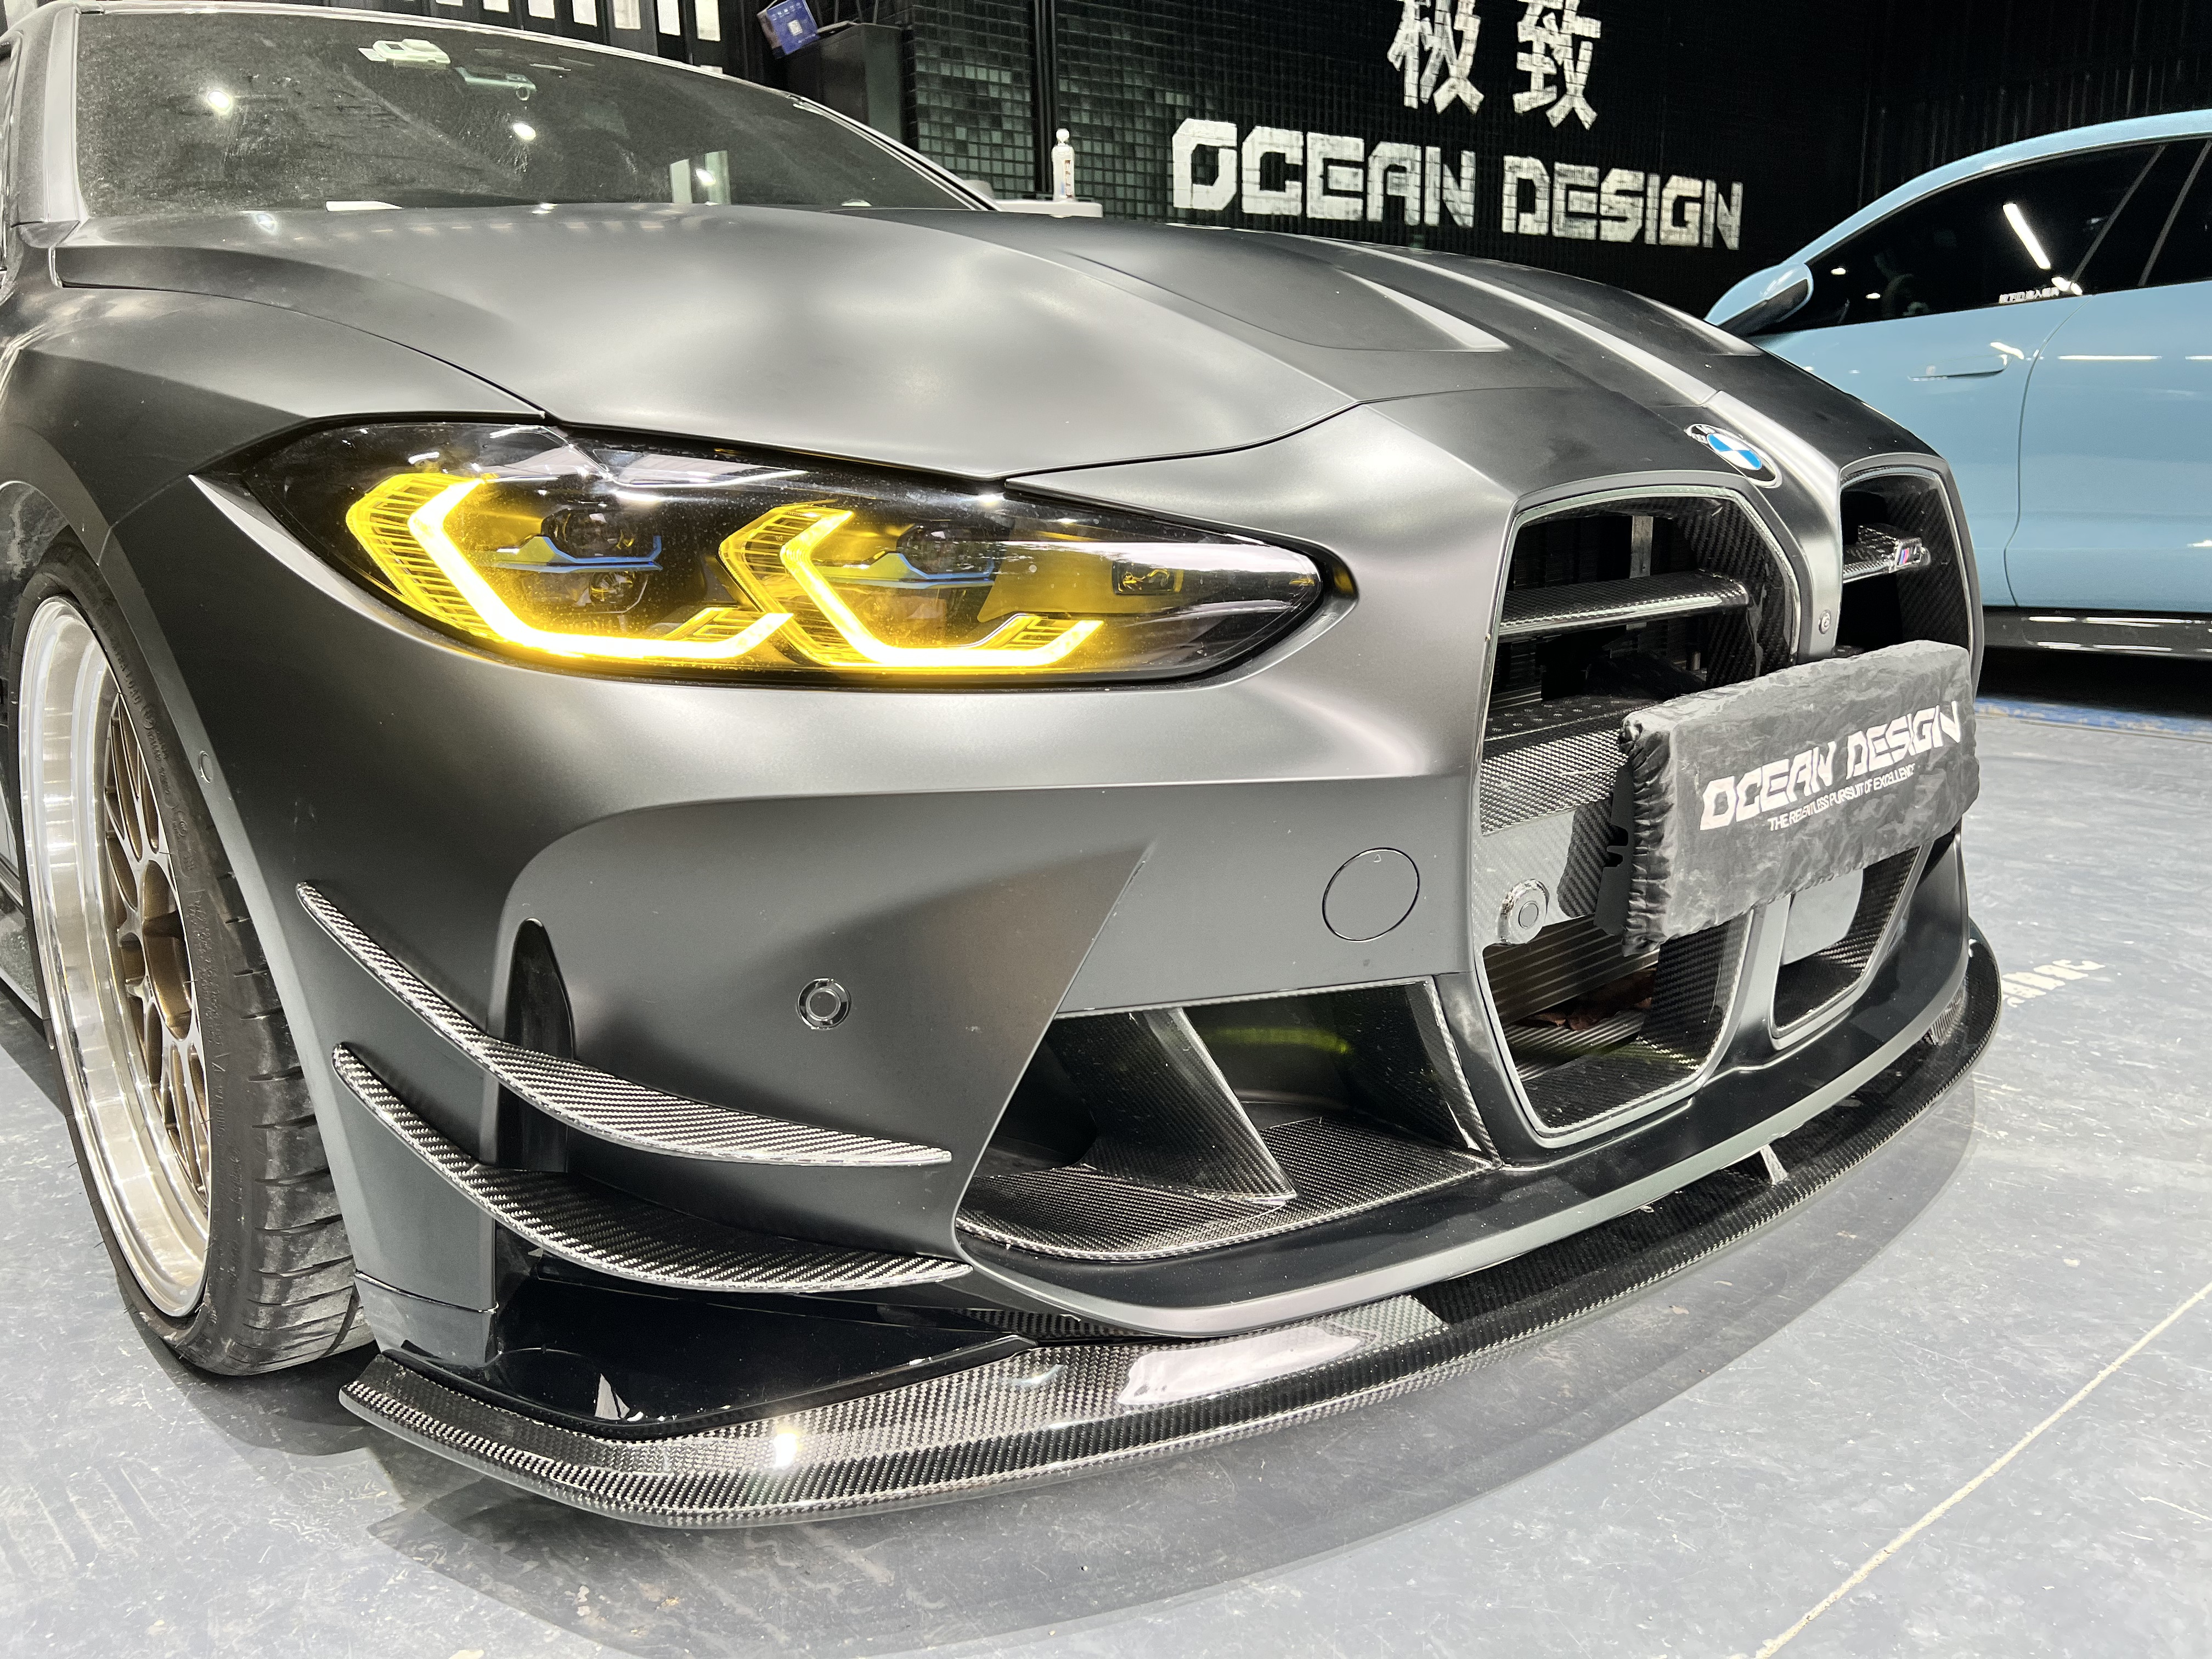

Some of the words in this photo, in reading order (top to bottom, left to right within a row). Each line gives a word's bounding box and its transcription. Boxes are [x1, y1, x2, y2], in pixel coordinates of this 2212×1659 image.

[1387, 0, 1601, 130] 极致
[1172, 117, 1476, 228] OCEAN
[1502, 155, 1743, 250] DESIGN
[1700, 741, 1836, 831] OCEAN
[1846, 700, 1962, 781] DESIGN
[1767, 812, 1790, 831] THE
[1789, 794, 1830, 825] RELENTLESS
[1829, 782, 1864, 806] PURSUIT
[1864, 778, 1874, 794] OF
